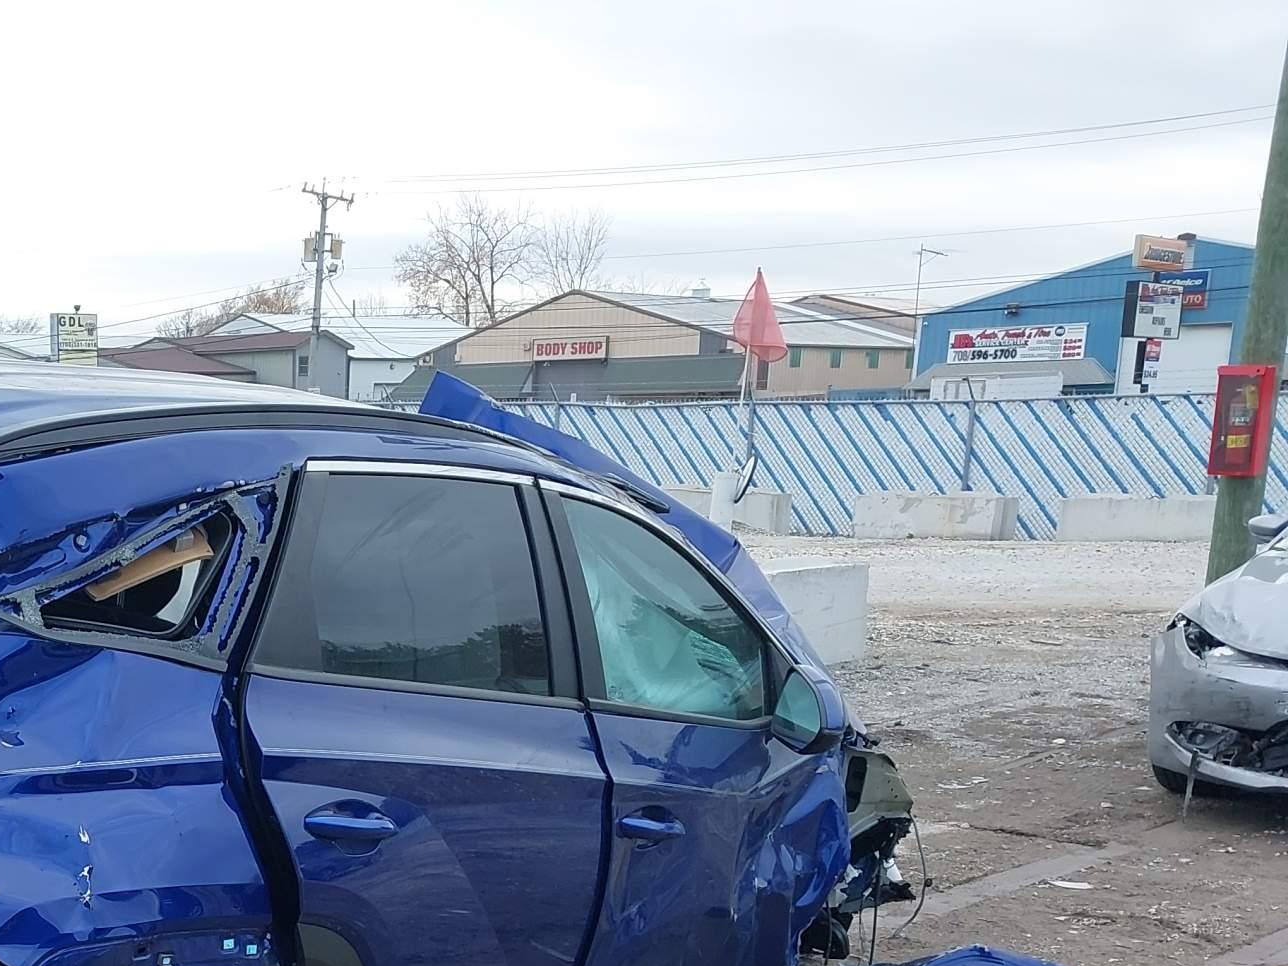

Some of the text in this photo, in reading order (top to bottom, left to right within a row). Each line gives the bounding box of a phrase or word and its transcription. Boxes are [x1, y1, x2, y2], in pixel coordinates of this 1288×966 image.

[1183, 295, 1202, 304] UTO
[59, 316, 84, 327] GDL
[536, 341, 603, 356] BODY SHOP
[952, 348, 1017, 362] 708/596-5700
